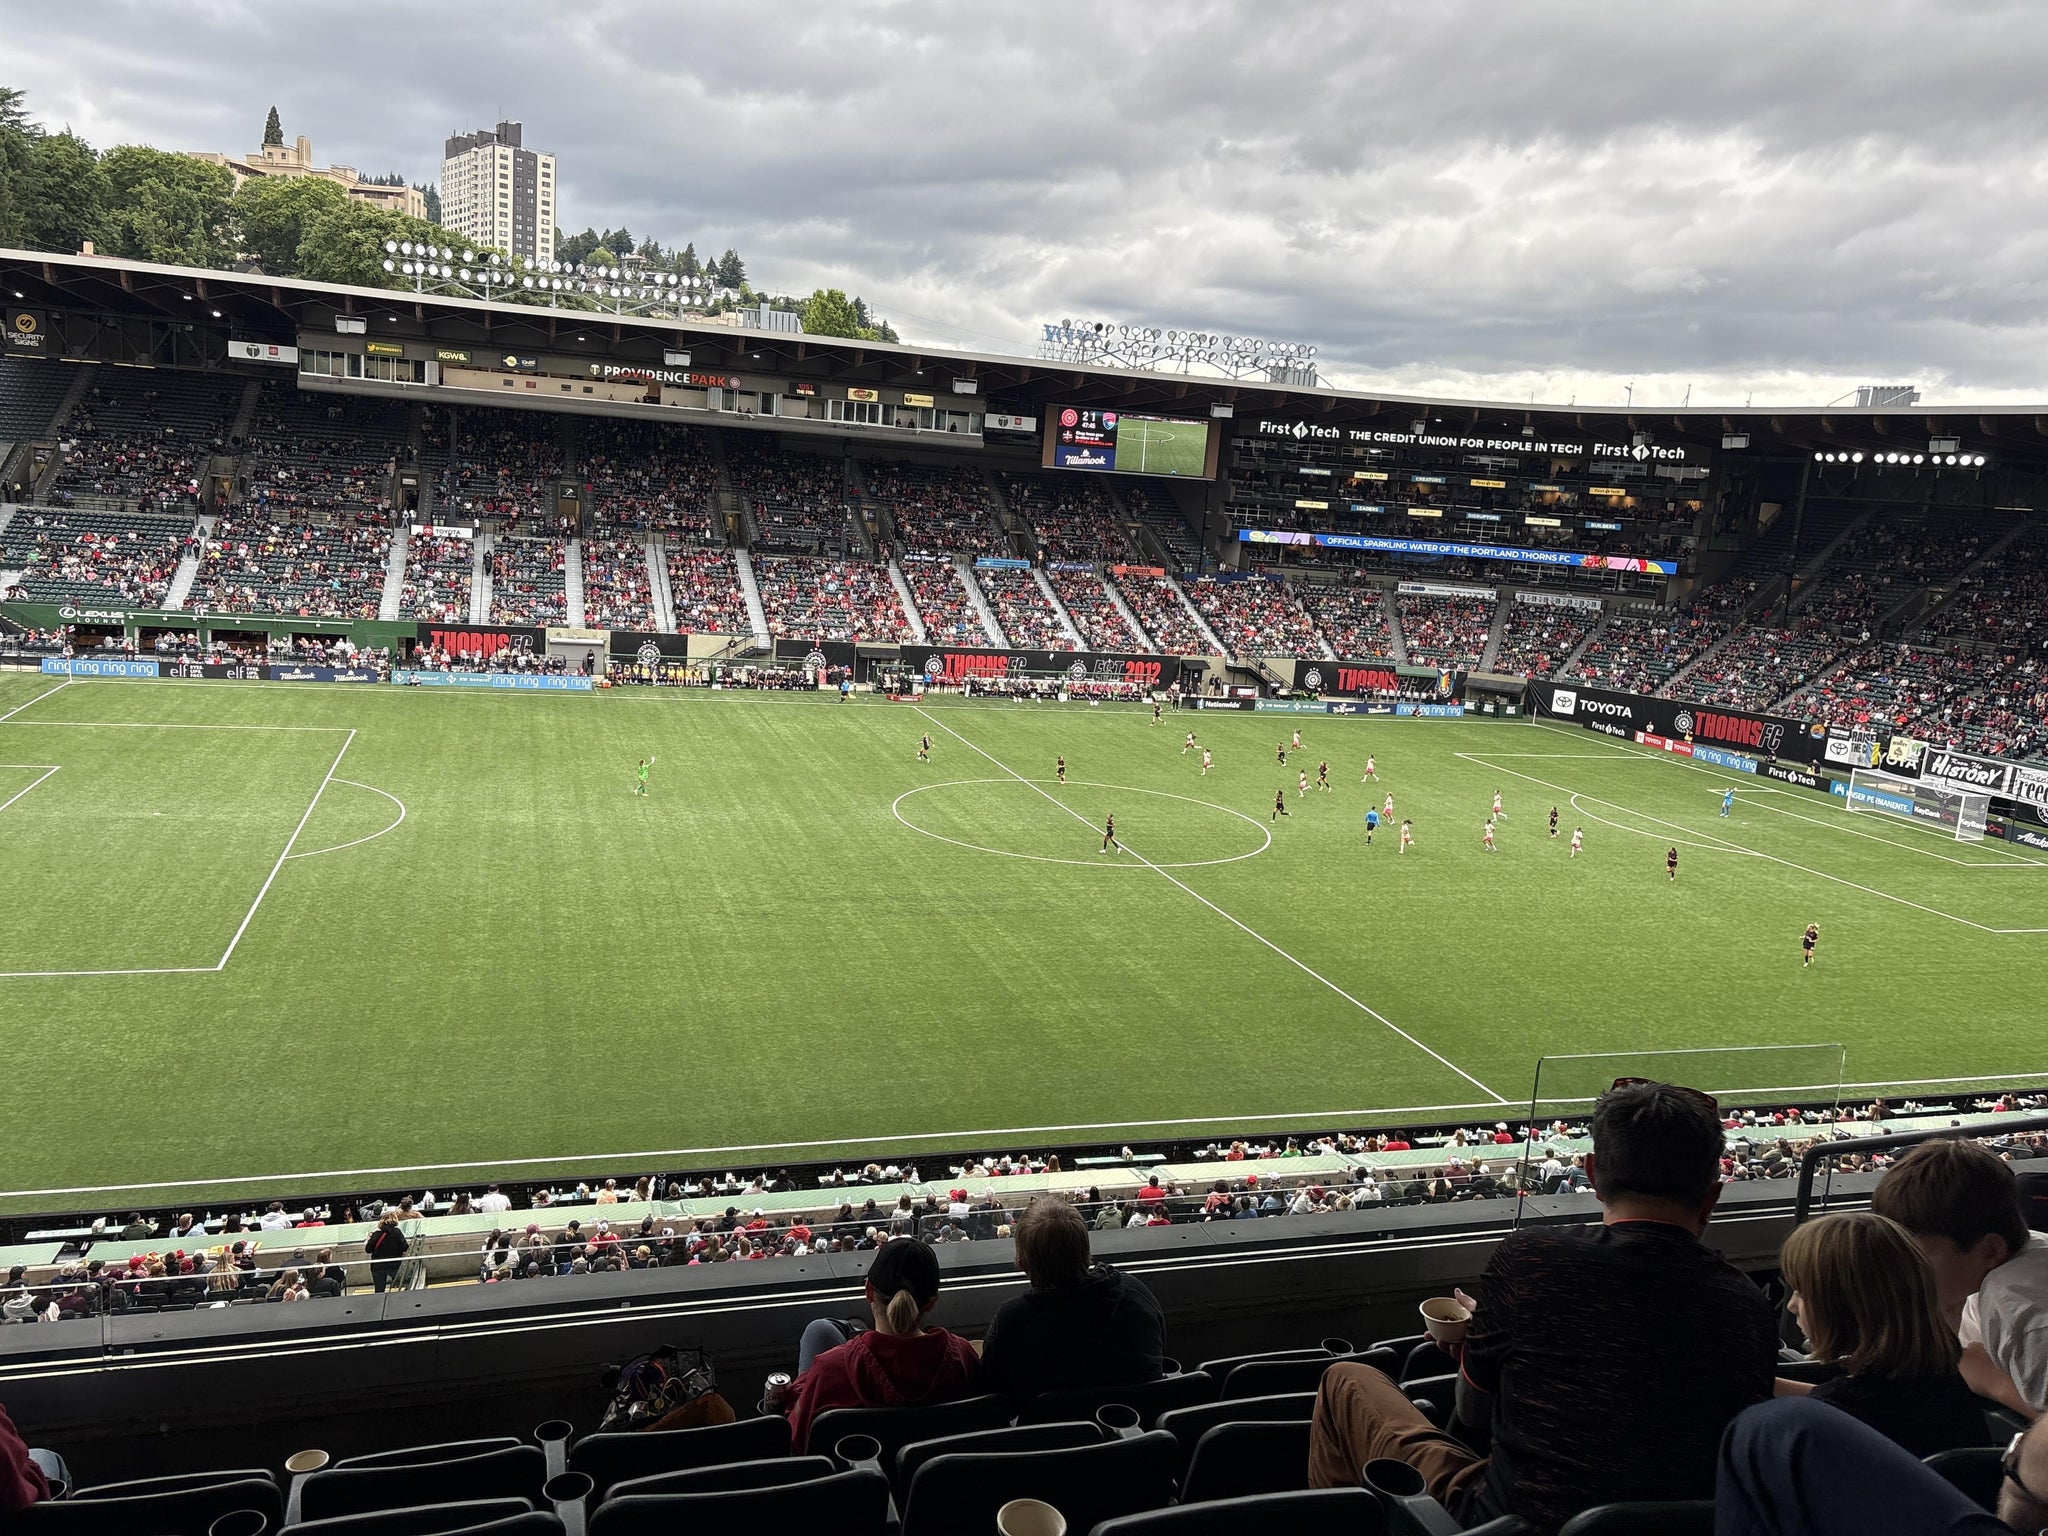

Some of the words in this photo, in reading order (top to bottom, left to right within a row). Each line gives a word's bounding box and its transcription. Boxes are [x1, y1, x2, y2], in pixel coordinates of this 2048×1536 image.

[7, 332, 45, 341] SECURITY
[14, 339, 39, 347] SIGNS
[1082, 411, 1089, 421] 2
[1090, 412, 1096, 422] 1
[1259, 421, 1290, 435] First
[1310, 425, 1340, 438] Tech
[1349, 430, 1372, 440] THE
[1373, 432, 1416, 444] CREDIT
[1418, 435, 1457, 446] UNION
[1460, 438, 1484, 448] FOR
[1487, 440, 1532, 452] PEOPLE
[1534, 442, 1548, 452] IN
[1550, 443, 1583, 454] TECH
[1593, 443, 1629, 457] First
[1651, 446, 1685, 459] Tech
[1065, 455, 1106, 465] Tillamook
[1327, 537, 1362, 546] OFFICIAL
[1363, 539, 1408, 550] SPARKLING
[1409, 543, 1438, 552] WATER
[1439, 545, 1451, 553] OF
[1452, 546, 1469, 554] THE
[1471, 547, 1519, 558] PORTLAND
[1521, 551, 1557, 561] THORNS
[1558, 555, 1571, 563] FC
[77, 610, 125, 618] LEXUS
[430, 630, 510, 659] THORNS
[47, 661, 71, 673] ring
[76, 661, 99, 675] ring
[103, 661, 126, 675] ring
[131, 662, 154, 676] ring
[170, 664, 189, 678] elf
[226, 665, 246, 679] elf
[944, 653, 1008, 678] THORNS
[1125, 660, 1162, 685] 2012
[279, 672, 316, 680] Tillamook
[333, 674, 369, 682] Tillamook
[495, 675, 515, 687] ring
[519, 675, 539, 688] ring
[547, 676, 567, 688] ring
[570, 677, 590, 689] ring
[1337, 668, 1398, 691] THORNS
[1431, 706, 1445, 716] ring
[1446, 707, 1461, 716] ring
[1579, 699, 1632, 718] TOYOTA
[1591, 721, 1605, 732] First
[1612, 726, 1625, 737] Tech
[1695, 711, 1764, 746] THORNS
[1757, 722, 1784, 751] FC
[1645, 736, 1662, 746] TOYOTA
[1852, 731, 1877, 743] RAISE
[1673, 743, 1691, 754] TOYOTA
[1850, 743, 1862, 753] THE
[1693, 746, 1707, 760] ring
[1707, 750, 1721, 763] ring
[1726, 755, 1741, 769] ring
[1742, 760, 1756, 774] ring
[1768, 766, 1787, 779] First
[1797, 775, 1815, 786] Tech
[1914, 805, 1940, 819] KeyBank
